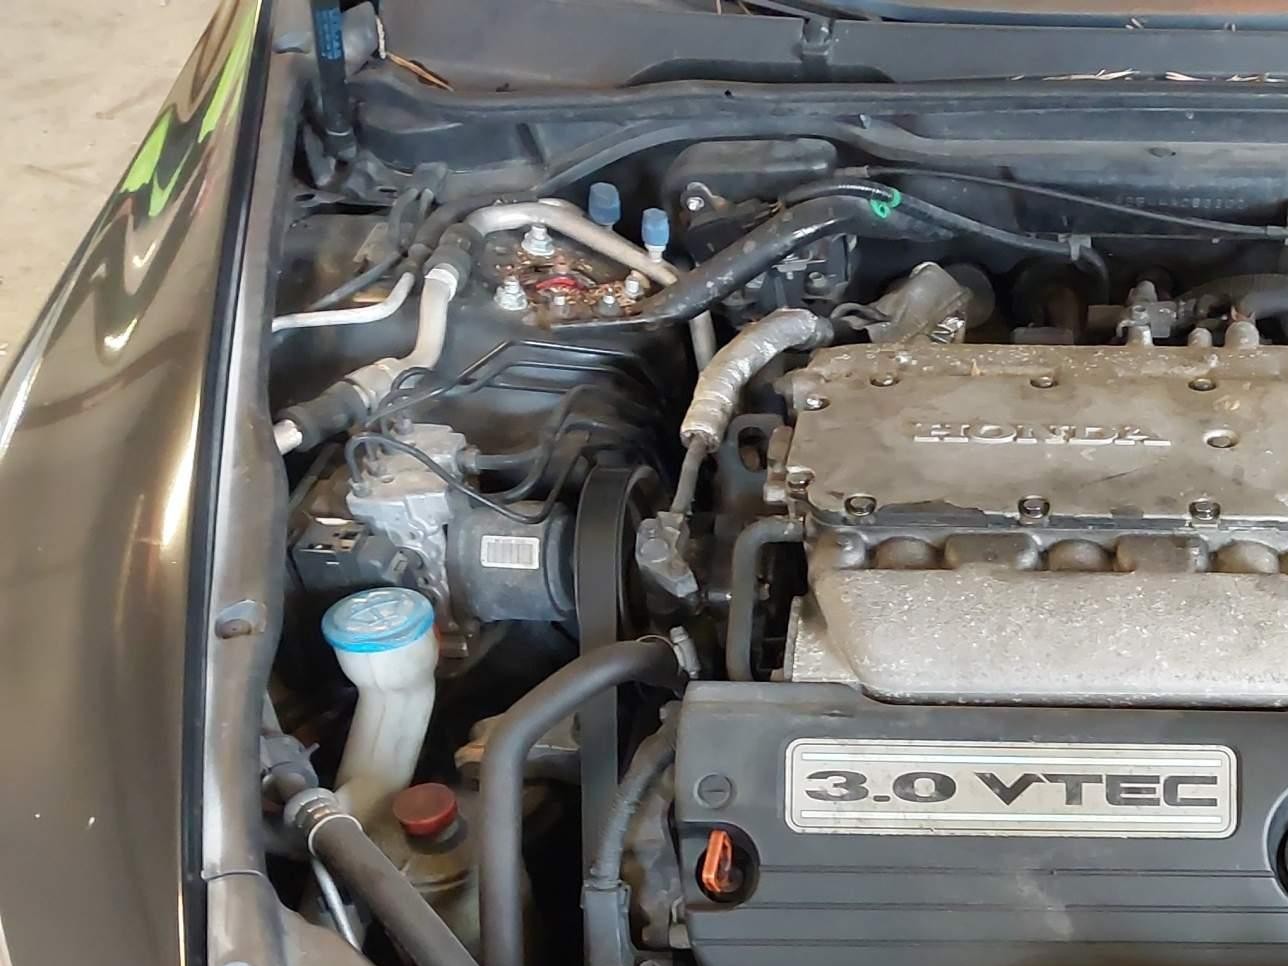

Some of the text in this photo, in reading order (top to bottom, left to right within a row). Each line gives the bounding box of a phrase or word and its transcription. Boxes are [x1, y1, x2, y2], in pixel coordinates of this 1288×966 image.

[913, 423, 1171, 447] HONDA
[805, 770, 1218, 807] 3.0 VTEC
